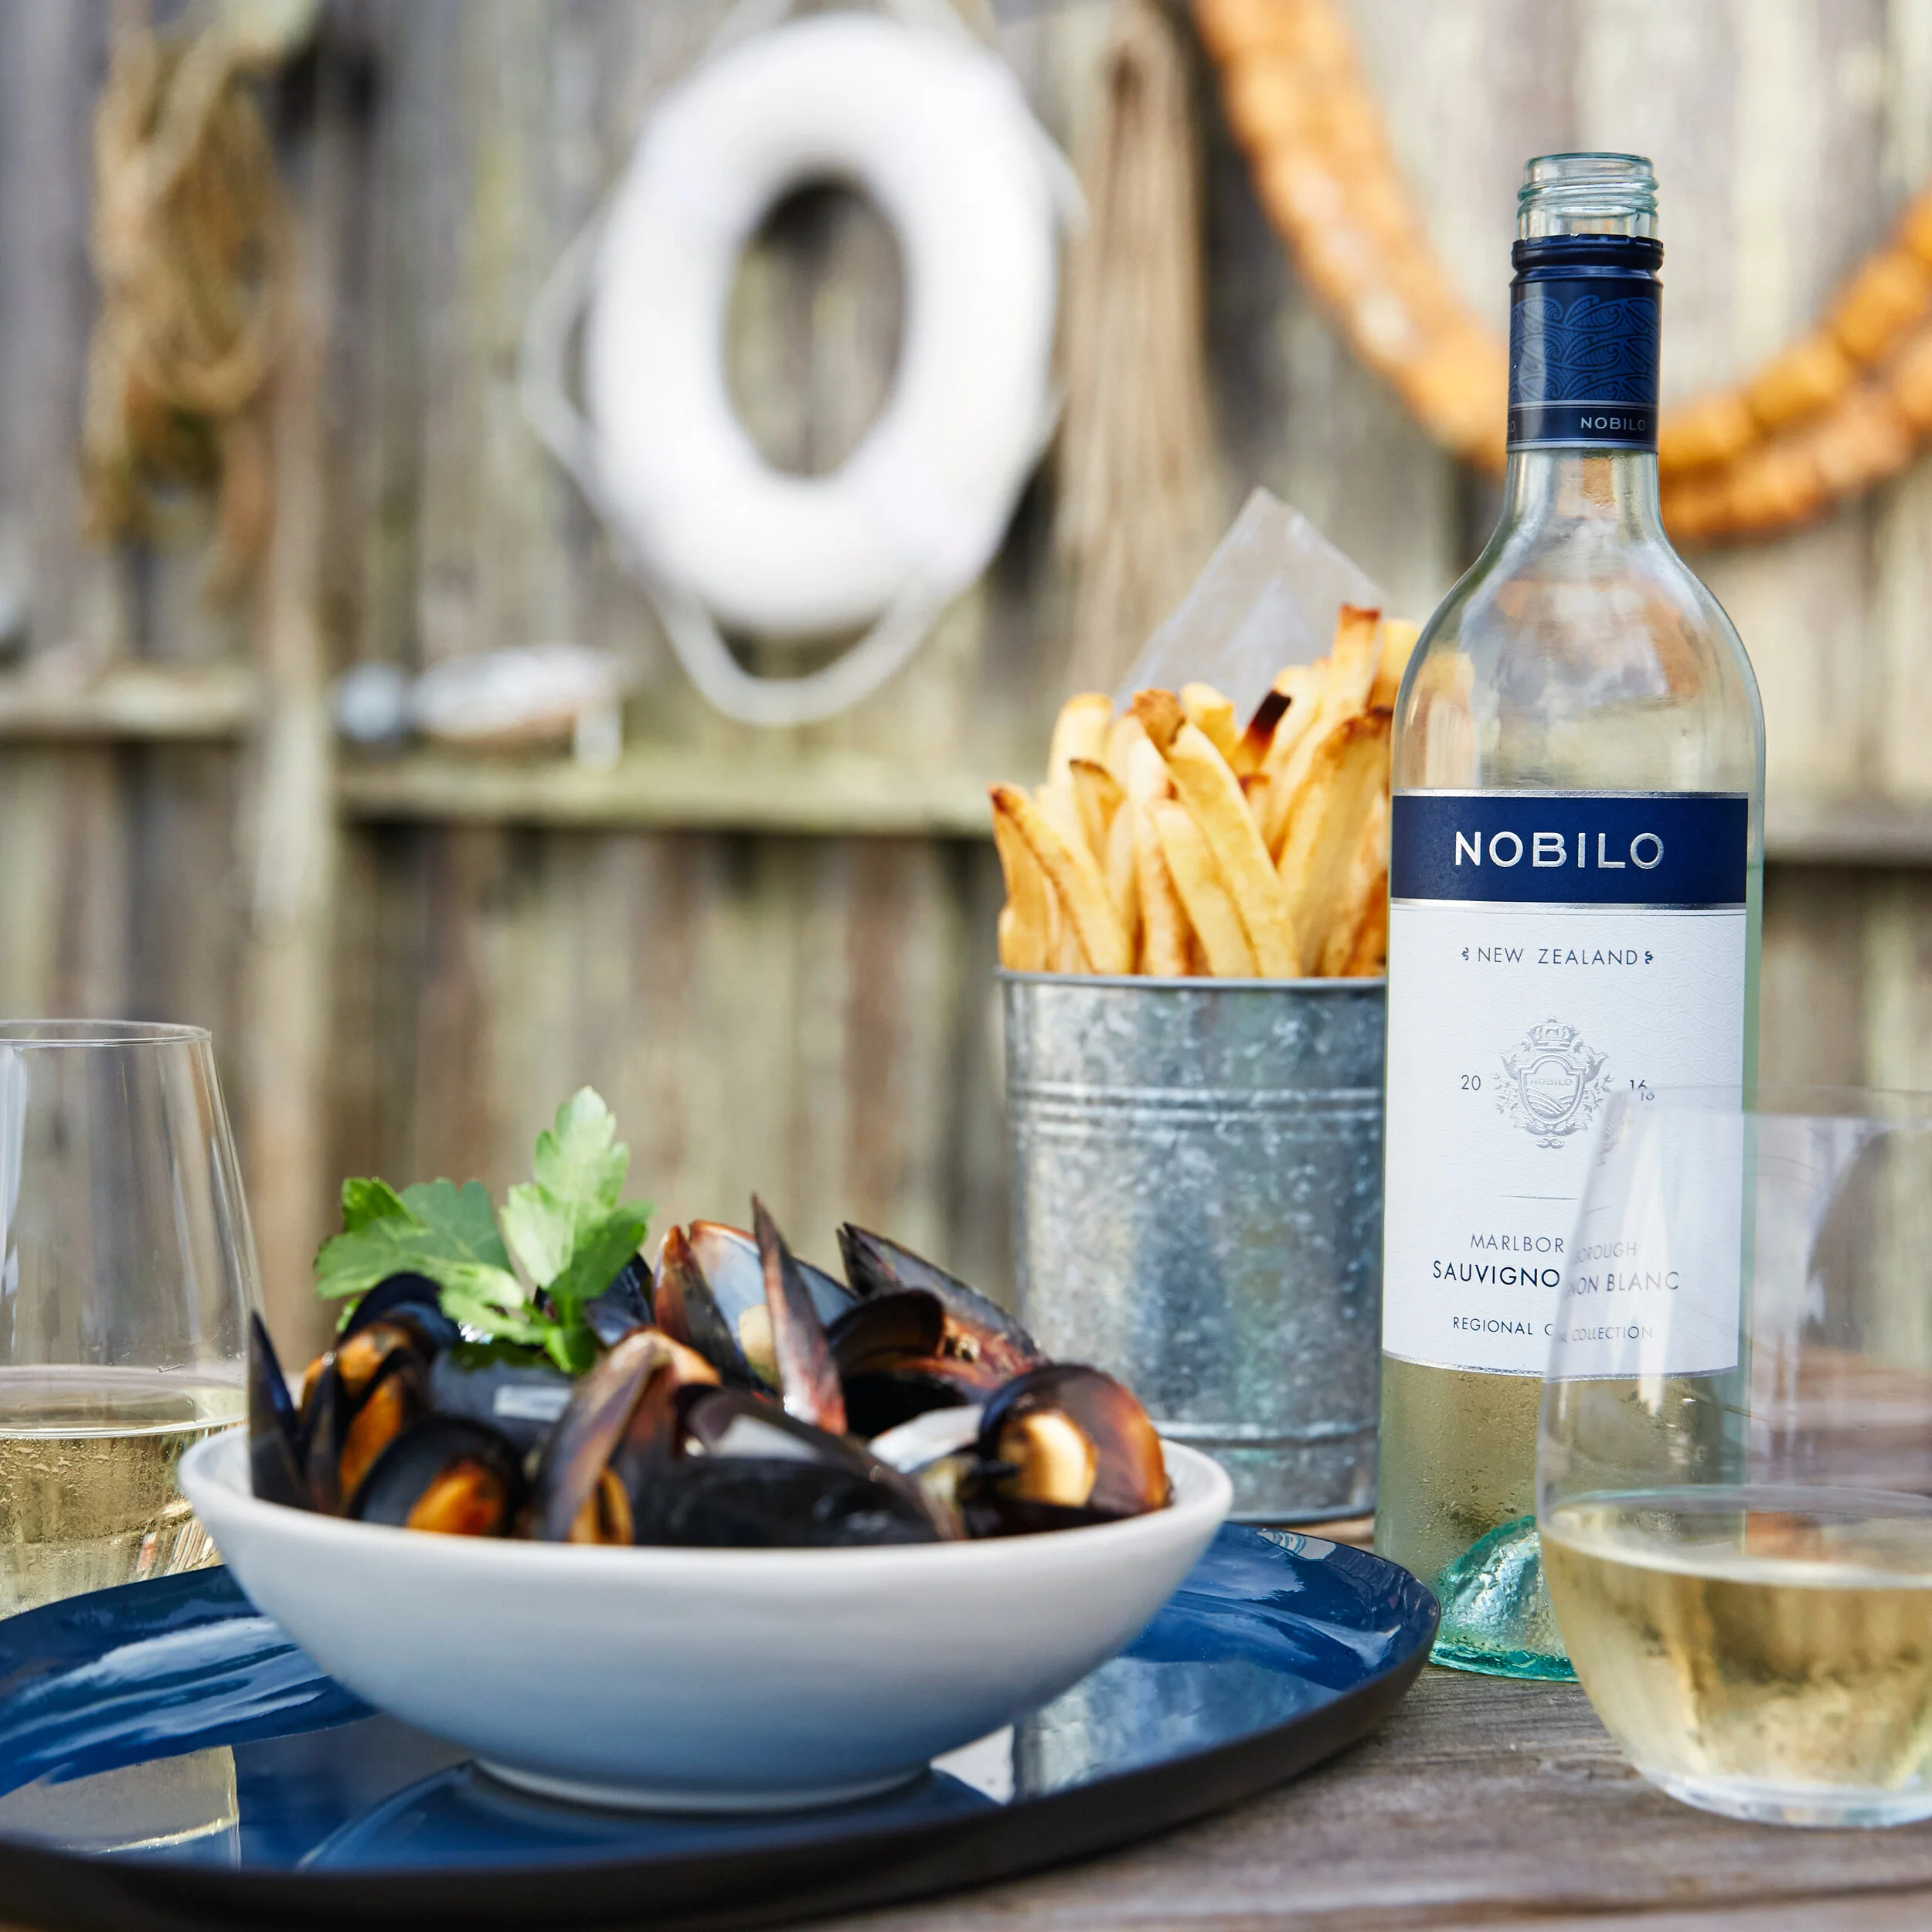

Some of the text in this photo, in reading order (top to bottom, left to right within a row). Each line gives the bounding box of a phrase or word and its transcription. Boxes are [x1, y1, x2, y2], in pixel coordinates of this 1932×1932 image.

[1580, 417, 1646, 431] NOBILO
[1454, 831, 1665, 869] NOBILO
[1478, 947, 1638, 965] NEW ZEALAND
[1461, 1074, 1481, 1090] 20
[1607, 1271, 1679, 1292] BLANC
[1453, 1316, 1533, 1335] REGIONAL
